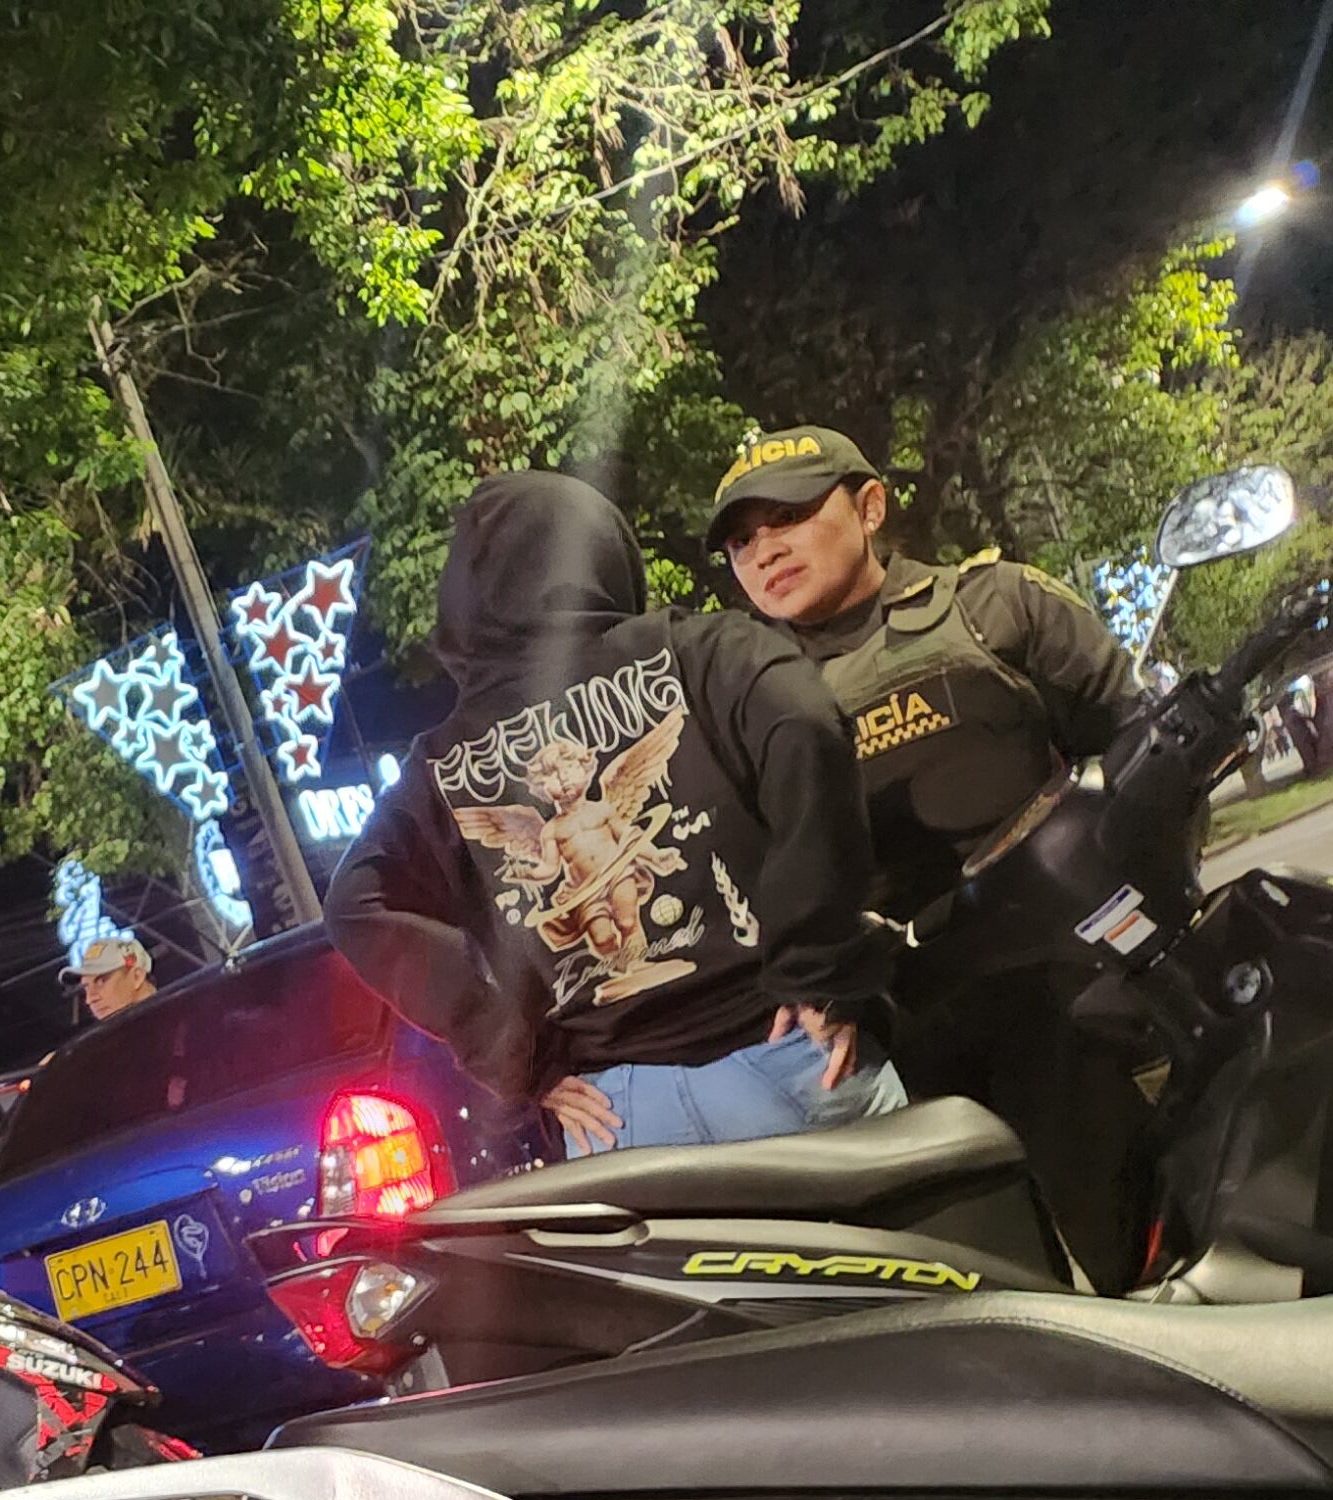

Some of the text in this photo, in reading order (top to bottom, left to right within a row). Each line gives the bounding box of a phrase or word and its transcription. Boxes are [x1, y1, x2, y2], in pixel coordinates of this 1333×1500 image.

[856, 692, 933, 745] ICÍA
[683, 1252, 981, 1291] CRYPTON
[5, 1351, 103, 1391] SUZUKI
